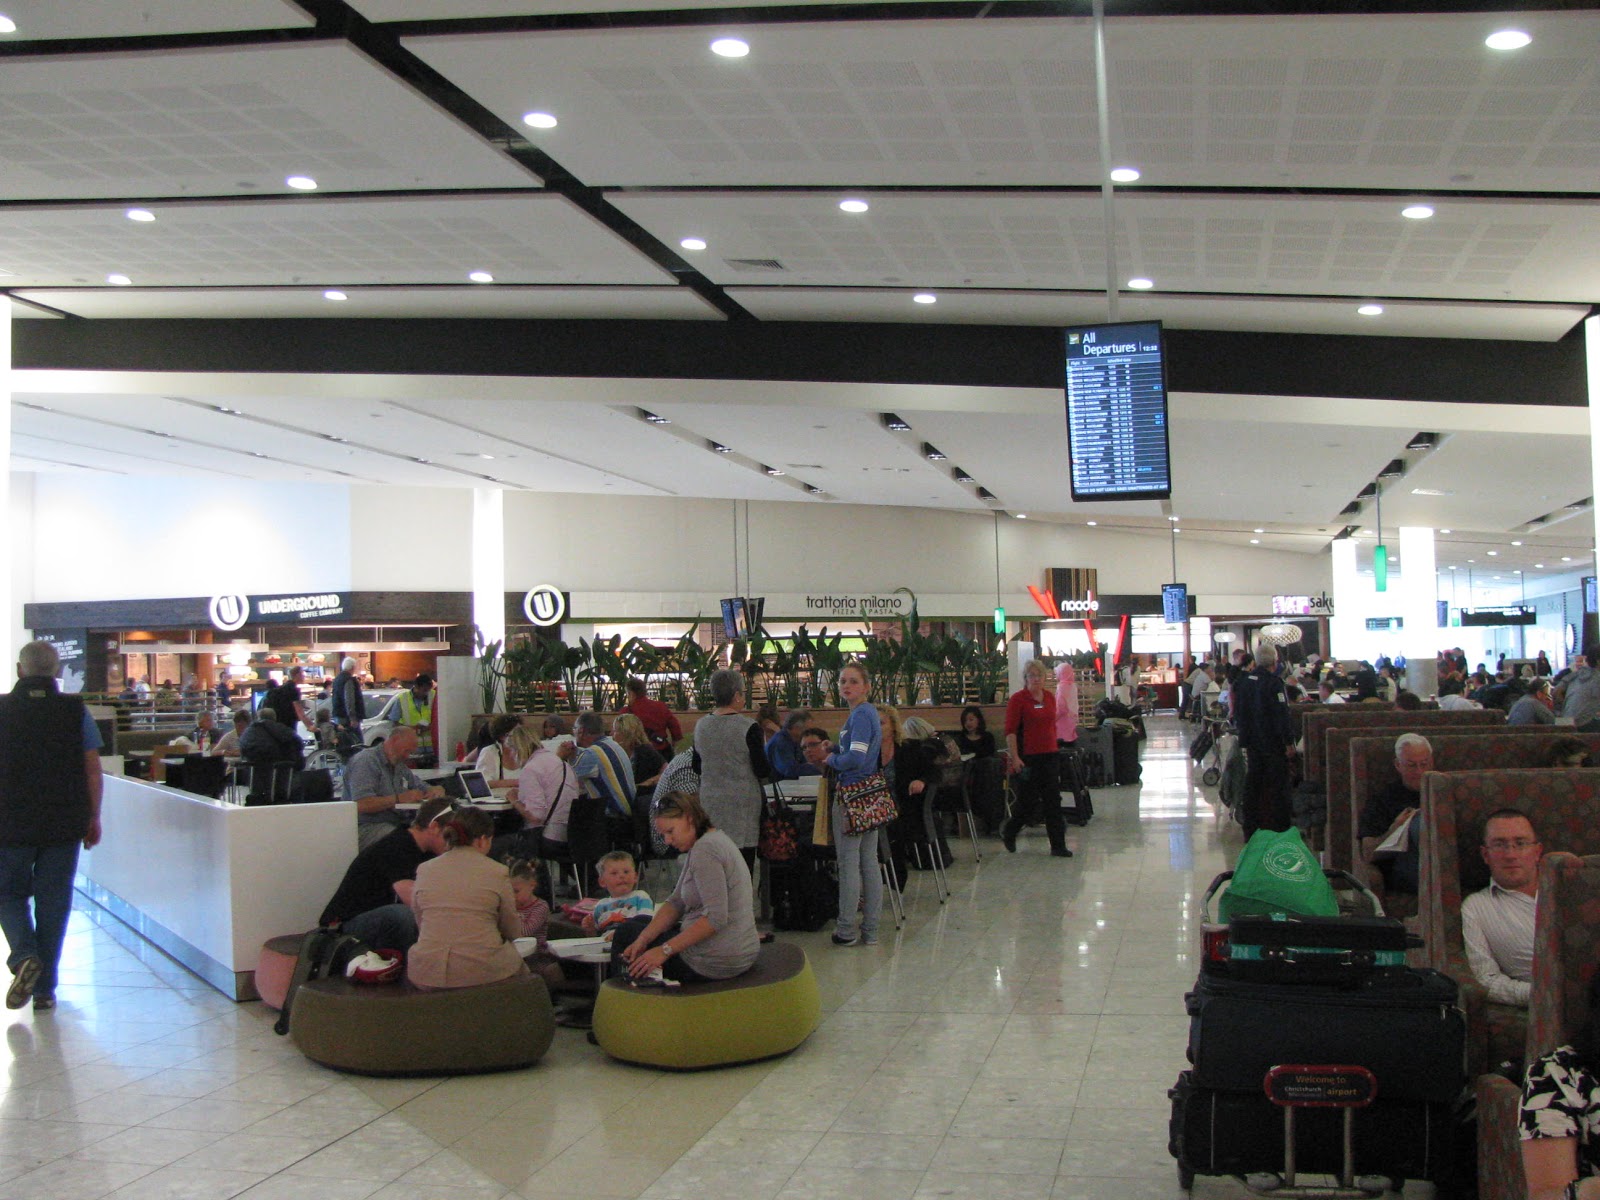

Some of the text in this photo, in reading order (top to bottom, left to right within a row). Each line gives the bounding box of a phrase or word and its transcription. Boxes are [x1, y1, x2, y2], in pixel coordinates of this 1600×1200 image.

[1082, 332, 1096, 344] All
[1083, 343, 1136, 357] Departures
[258, 594, 340, 614] UNDERGROUND
[806, 595, 902, 609] trattoria milano
[300, 607, 344, 619] COFFEE COMPANY
[1295, 1075, 1346, 1084] Welcome to
[1327, 1088, 1358, 1097] airport
